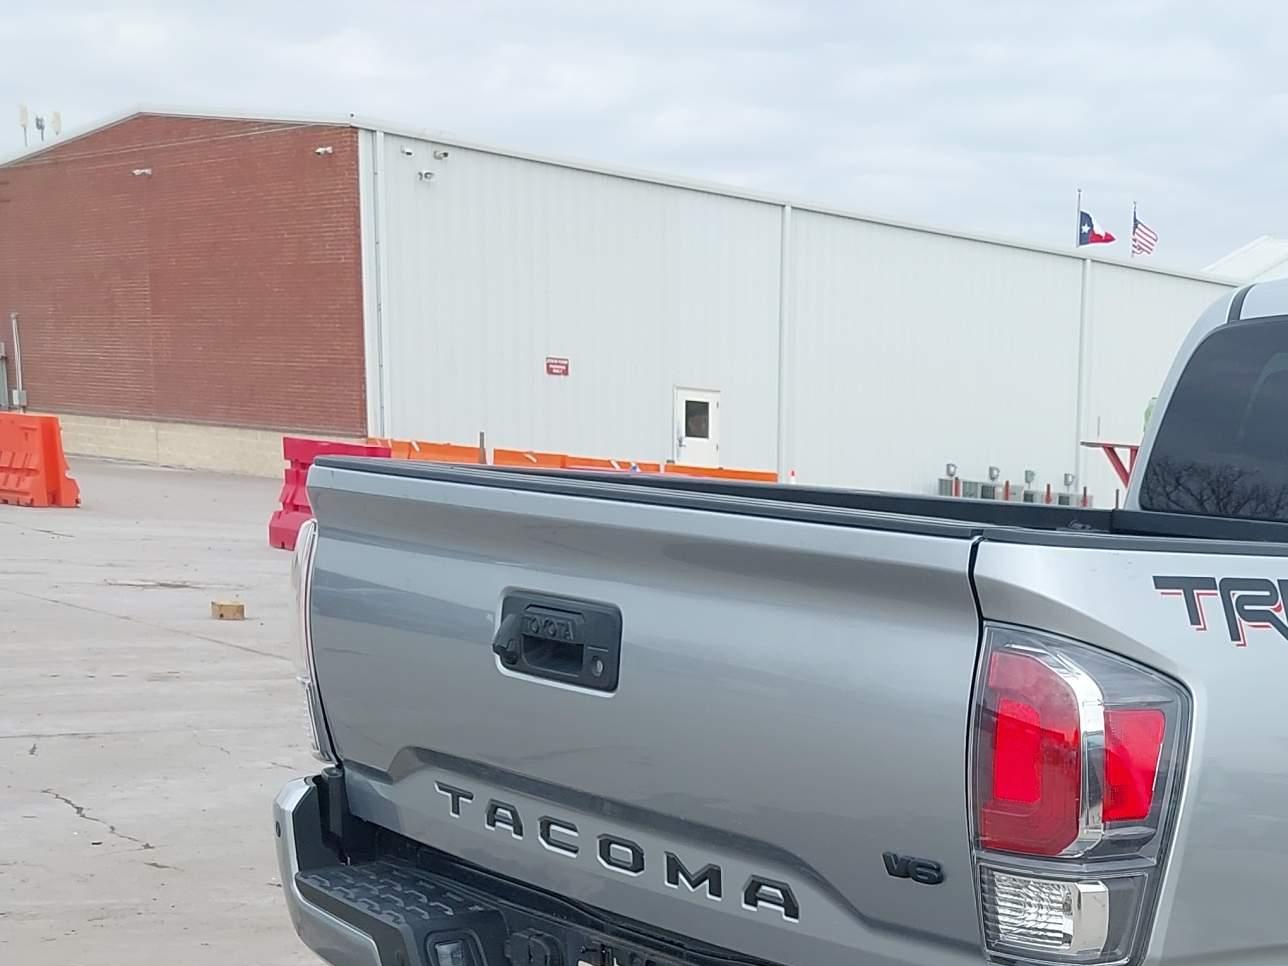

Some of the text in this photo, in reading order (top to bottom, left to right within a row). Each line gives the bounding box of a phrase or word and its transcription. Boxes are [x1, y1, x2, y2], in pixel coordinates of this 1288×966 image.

[521, 613, 576, 641] TOYOTA
[434, 780, 800, 923] TACOMA
[882, 851, 945, 886] V6
